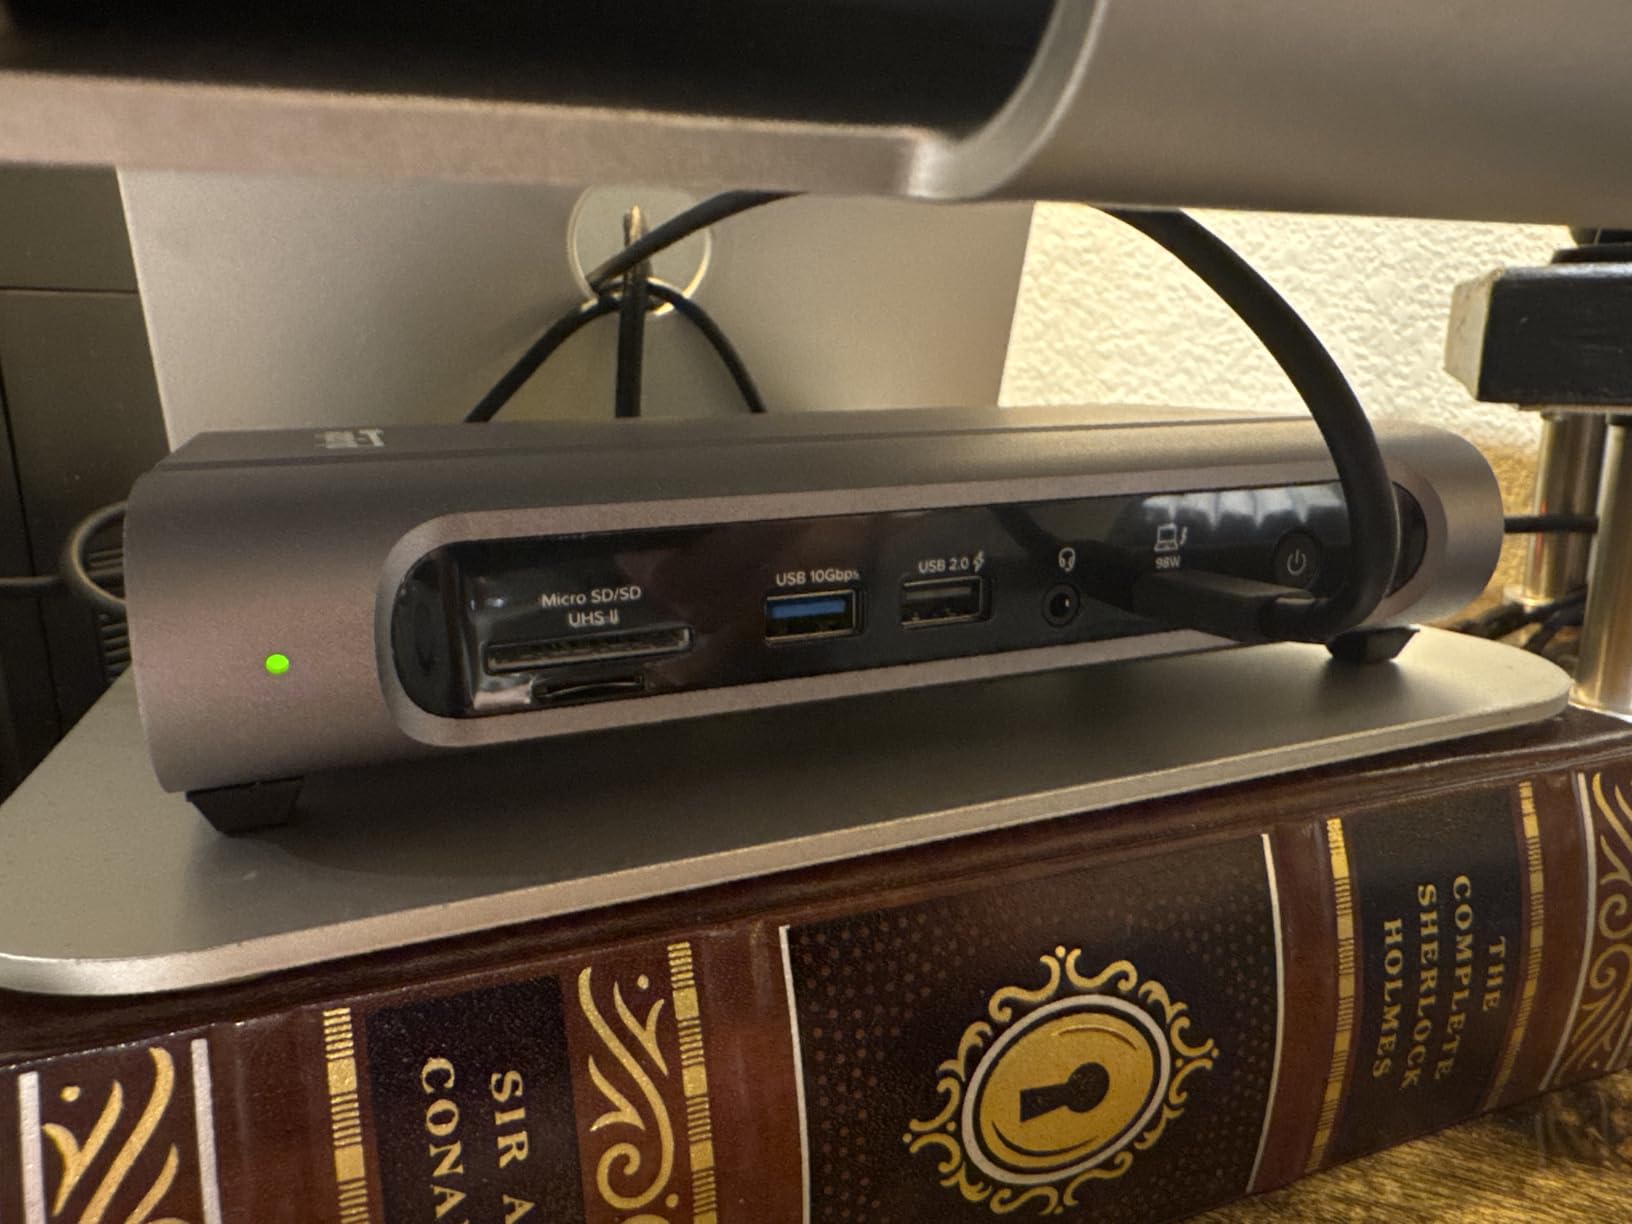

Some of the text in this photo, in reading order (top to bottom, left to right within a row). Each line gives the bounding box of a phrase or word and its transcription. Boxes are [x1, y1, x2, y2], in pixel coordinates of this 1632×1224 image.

[541, 585, 642, 608] Micro SD/SD
[776, 567, 860, 586] USB 10Gbps
[919, 556, 970, 573] USB 2.0
[1372, 918, 1404, 1079] HOLMES
[1401, 884, 1438, 1089] SHERLOCK
[1434, 875, 1473, 1080] COMPLETE
[1483, 936, 1506, 1012] THE
[420, 1057, 469, 1224] CONA
[490, 1070, 529, 1169] SIR
